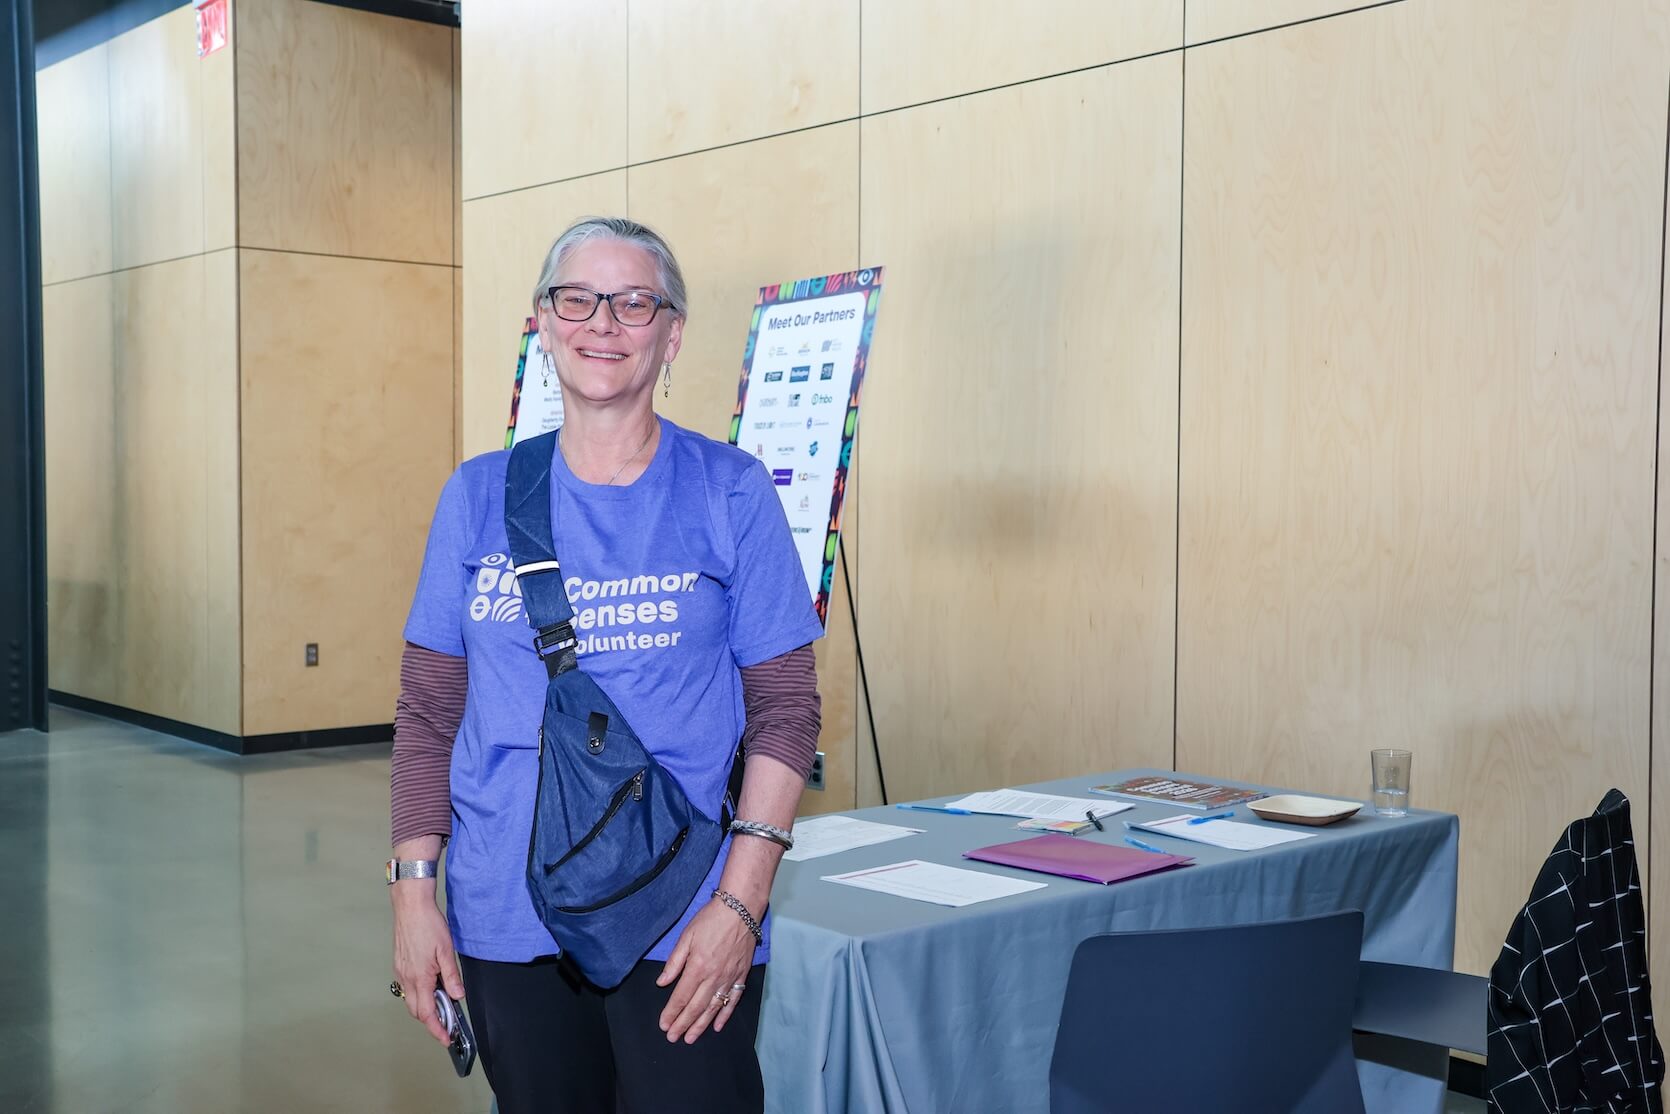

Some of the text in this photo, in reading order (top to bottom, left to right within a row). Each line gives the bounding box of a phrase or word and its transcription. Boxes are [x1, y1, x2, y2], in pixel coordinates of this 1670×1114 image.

[768, 308, 856, 330] Meet Our Partners
[564, 572, 699, 604] Common
